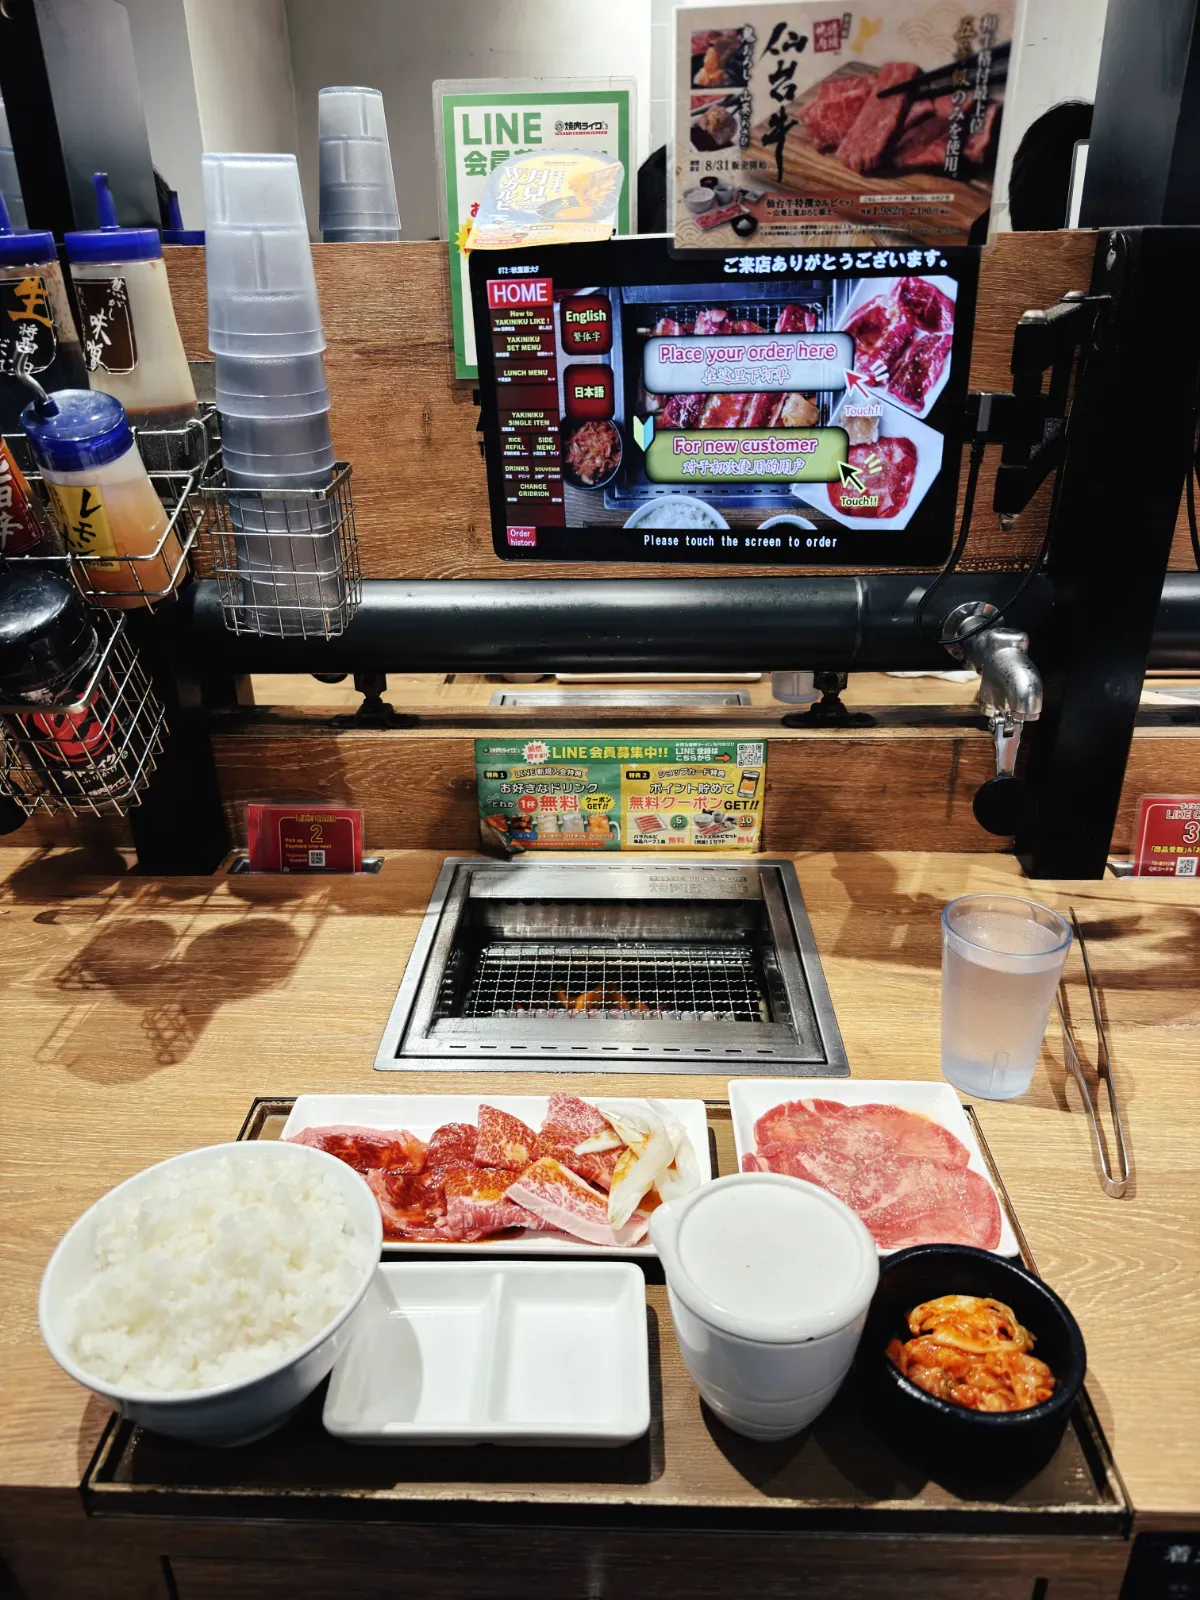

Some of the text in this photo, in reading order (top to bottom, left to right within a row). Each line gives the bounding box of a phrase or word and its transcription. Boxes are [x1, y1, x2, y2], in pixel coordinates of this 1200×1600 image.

[759, 22, 809, 183] 仙台牛
[462, 112, 543, 145] LINE
[705, 160, 729, 171] 8/31
[523, 168, 550, 202] 月見
[723, 249, 948, 274] ご来店ありがとうございます。
[493, 283, 548, 303] HOME
[7, 277, 52, 328] 生
[566, 310, 607, 324] English
[572, 331, 601, 342] 繁体字
[659, 341, 837, 366] Place your order here
[701, 366, 790, 385] 在这里下订单
[574, 386, 605, 398] 日本語
[844, 405, 884, 417] Touch!!
[672, 437, 818, 455] For new customer
[682, 459, 805, 476] 对于初次使用的用户
[840, 496, 878, 507] Touch!!
[510, 528, 530, 538] Order
[510, 539, 536, 547] history
[643, 534, 837, 548] Please touch the screen to order
[552, 746, 668, 760] LINE 会員募集中!!
[697, 747, 718, 755] 登録は
[515, 768, 582, 778] LINE 新規入会特典
[658, 767, 726, 779] ショップカード特典
[500, 783, 599, 794] お好きなドリンク
[650, 783, 735, 795] ポイント貯めて
[492, 800, 516, 808] どれか
[521, 799, 536, 809] 1杯
[539, 794, 580, 812] 無料
[587, 802, 609, 810] GET!!
[628, 795, 723, 810] 無料クーポン
[724, 800, 760, 810] GET!!
[676, 816, 682, 824] 5
[741, 816, 752, 824] 10
[1166, 809, 1192, 819] LIKE
[310, 824, 323, 843] 2
[1182, 820, 1200, 844] 3
